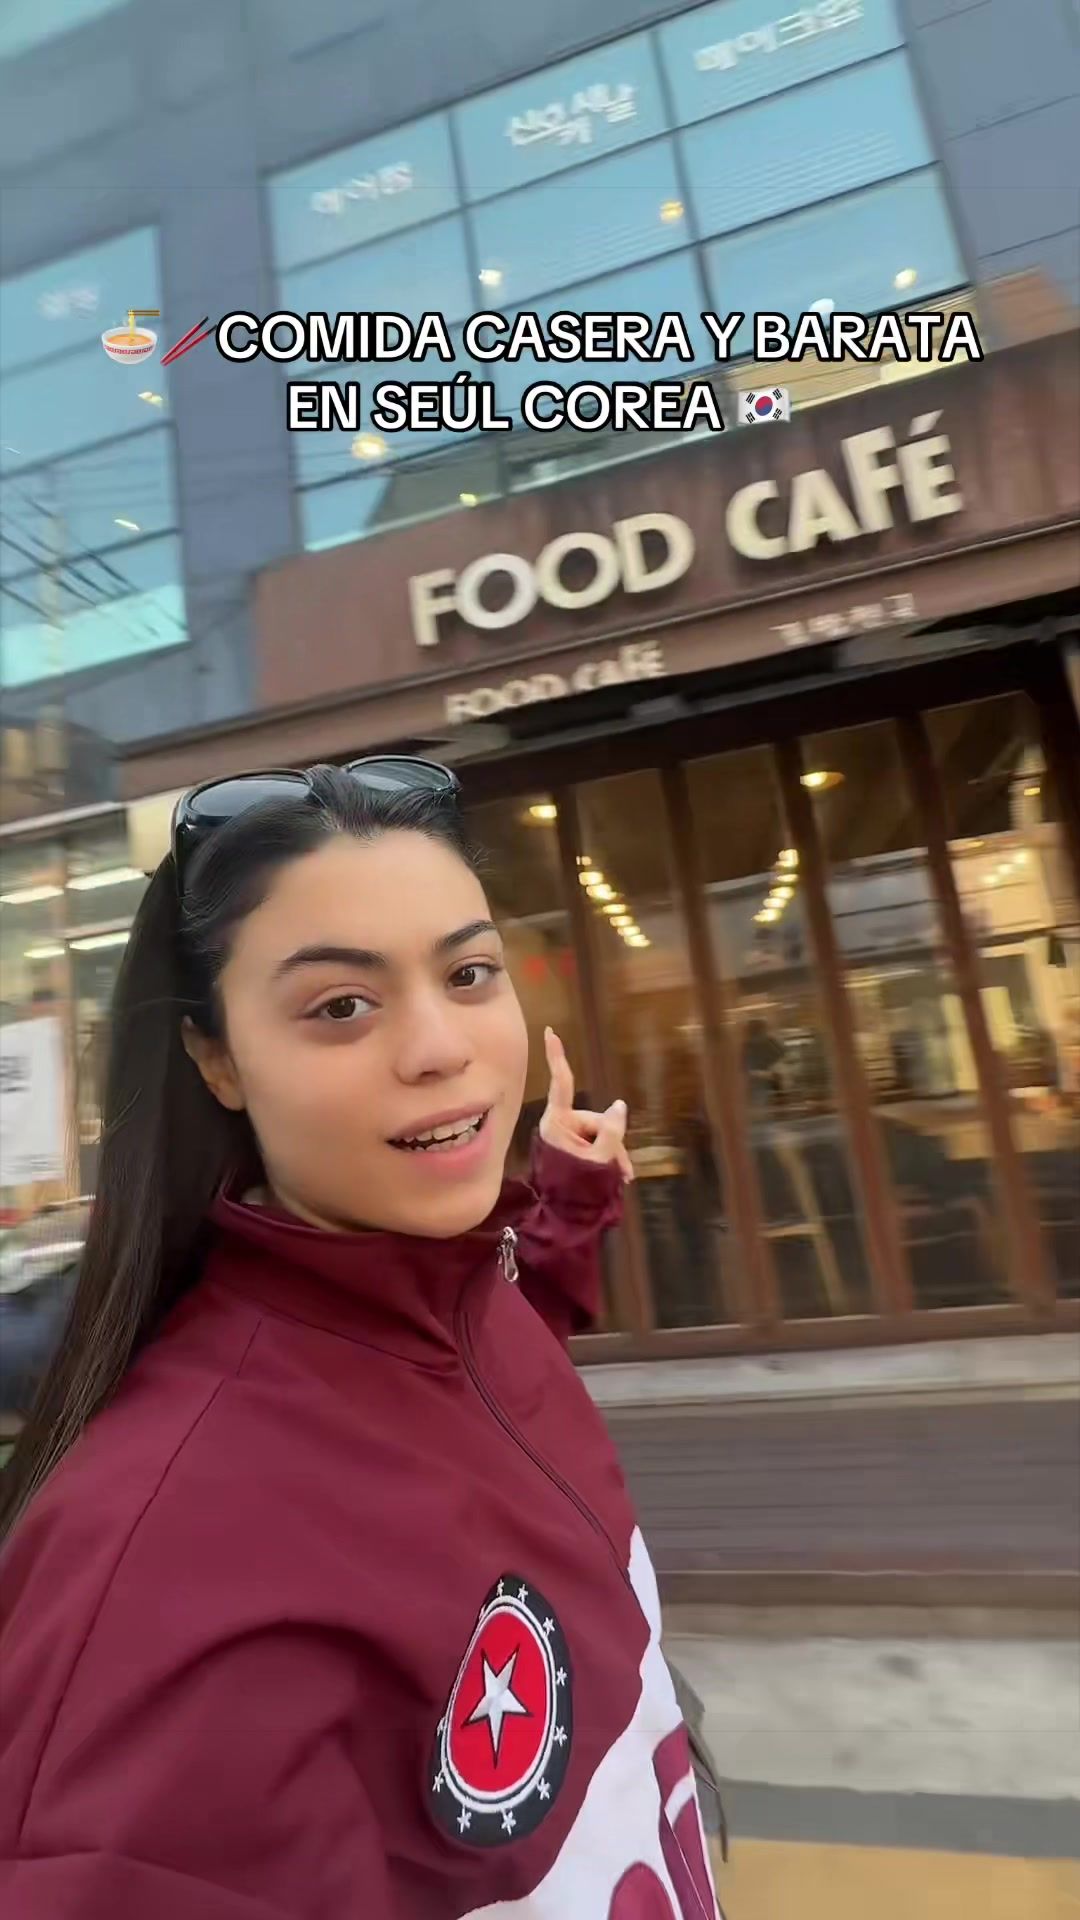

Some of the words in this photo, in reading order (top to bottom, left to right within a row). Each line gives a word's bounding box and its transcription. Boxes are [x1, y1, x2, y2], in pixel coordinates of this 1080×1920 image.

[408, 512, 695, 646] FOOD
[726, 410, 963, 560] CAFÉ
[445, 673, 569, 724] FOOD
